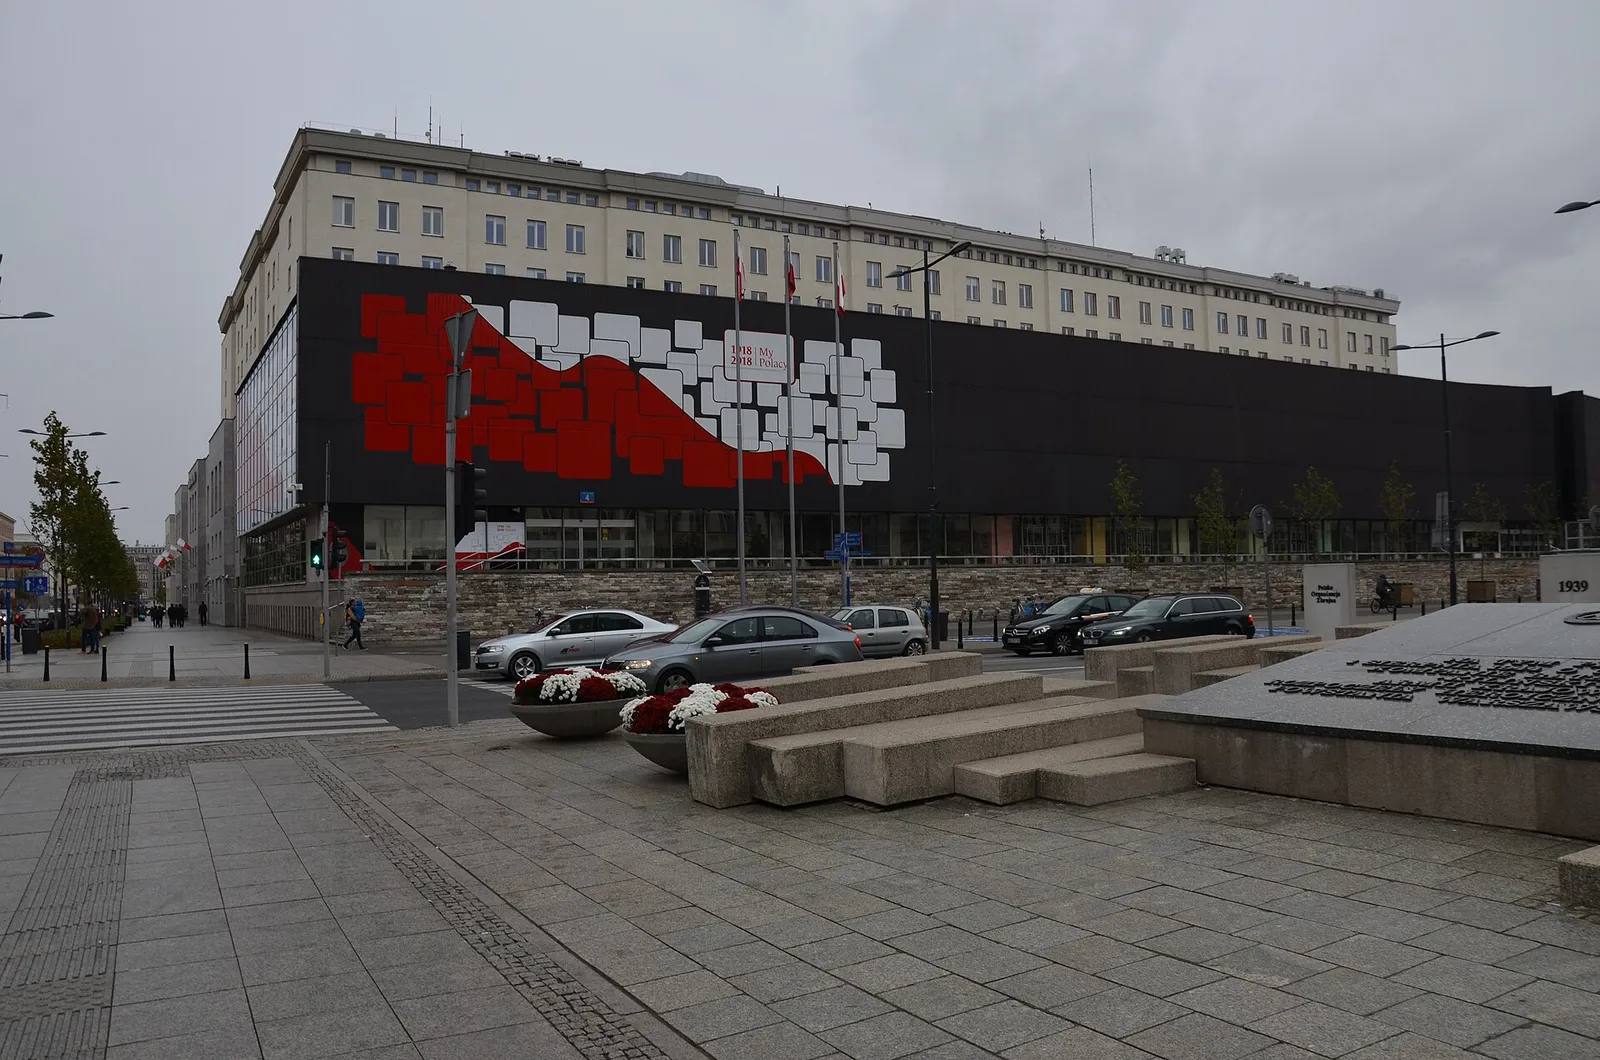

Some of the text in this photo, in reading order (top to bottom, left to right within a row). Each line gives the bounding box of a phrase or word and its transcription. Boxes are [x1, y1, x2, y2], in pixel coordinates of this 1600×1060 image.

[731, 345, 752, 355] 118
[759, 347, 773, 359] My
[731, 356, 752, 366] 218
[759, 358, 788, 370] Polacy
[1558, 580, 1589, 592] 1939
